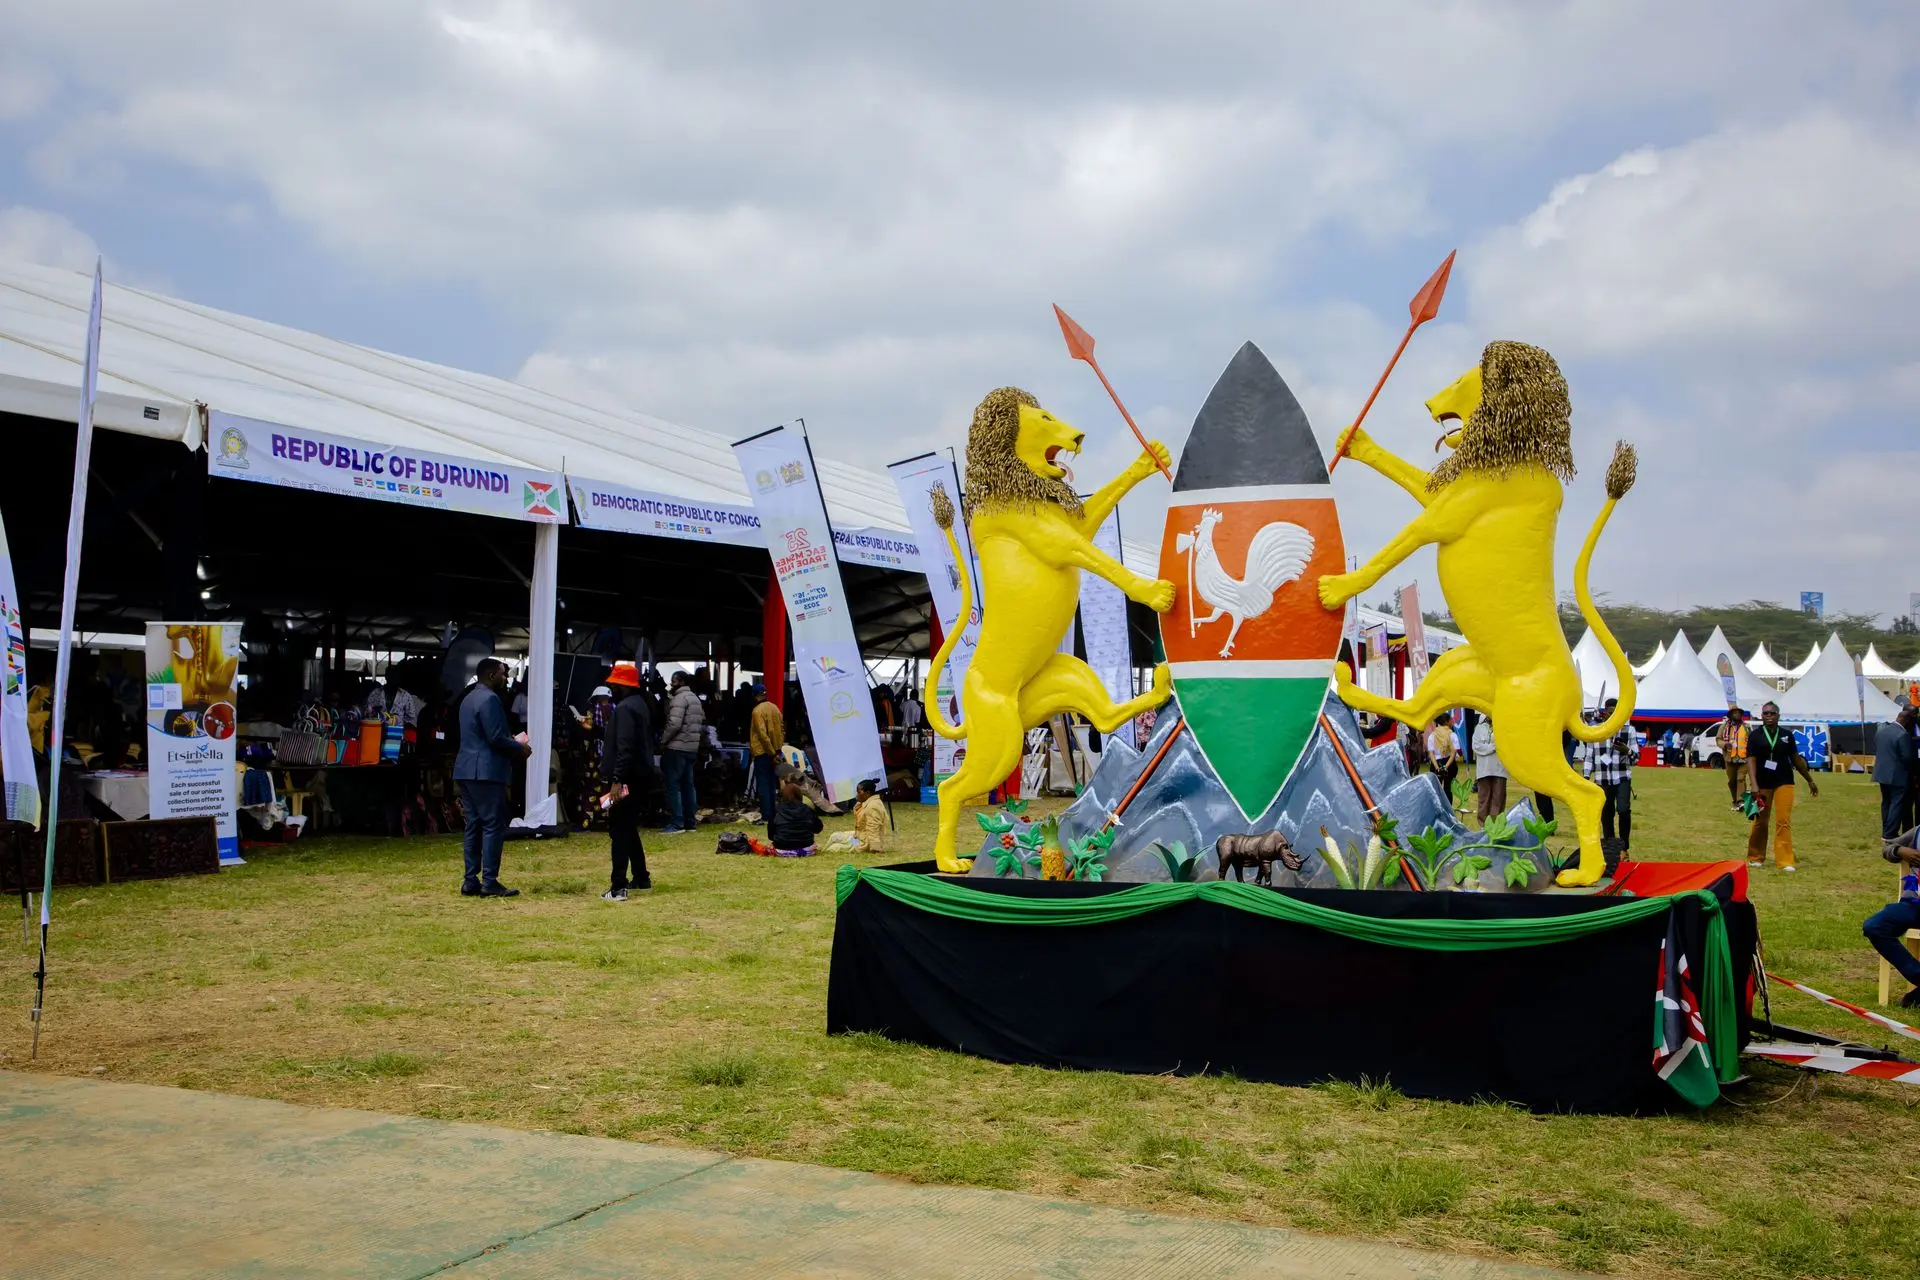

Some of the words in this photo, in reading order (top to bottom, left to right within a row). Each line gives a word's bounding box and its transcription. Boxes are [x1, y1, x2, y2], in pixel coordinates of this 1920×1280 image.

[272, 434, 384, 474] REPUBLIC
[389, 455, 416, 479] OF
[421, 460, 509, 493] BURUNDI
[592, 492, 663, 515] DEMOCRATIC
[665, 504, 713, 522] REPUBLIC
[714, 511, 727, 523] OF
[856, 536, 893, 551] REPUBLIC
[893, 542, 903, 553] OF
[168, 750, 223, 762] Etsirbella
[187, 780, 220, 788] successful
[201, 789, 222, 797] unique
[167, 797, 200, 805] collections
[170, 804, 221, 813] transformational
